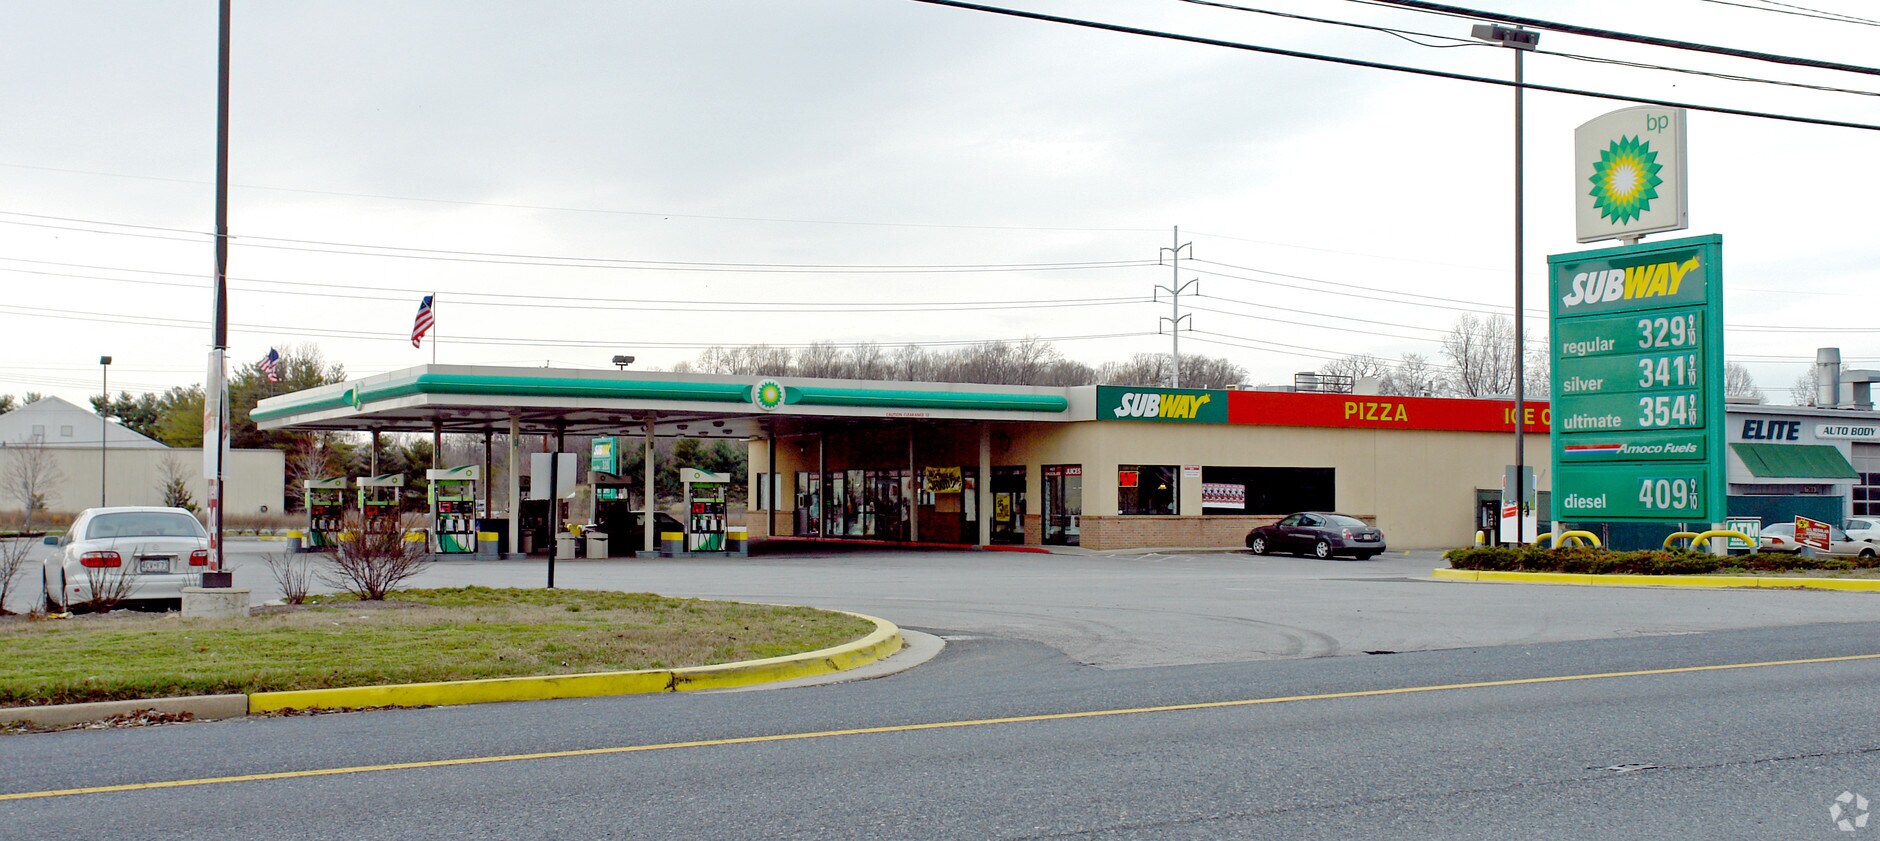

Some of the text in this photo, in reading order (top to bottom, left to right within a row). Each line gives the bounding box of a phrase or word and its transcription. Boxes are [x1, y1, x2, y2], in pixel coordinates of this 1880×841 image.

[1646, 113, 1668, 133] bp
[1563, 256, 1700, 308] SUBWAY
[1563, 337, 1615, 356] regular
[1638, 316, 1686, 348] 329
[1563, 377, 1603, 392] silver
[1639, 356, 1684, 388] 341
[1113, 393, 1211, 418] SUBWAY
[1344, 401, 1408, 421] PIZZA
[1639, 396, 1687, 427] 354
[1742, 420, 1801, 441] ELITE
[1823, 427, 1877, 436] AUTO BODY
[1616, 442, 1698, 454] Amoco Fuels
[1065, 467, 1082, 475] JUICES
[1564, 494, 1606, 509] diesel
[1639, 478, 1688, 509] 409
[1730, 522, 1759, 538] ATM
